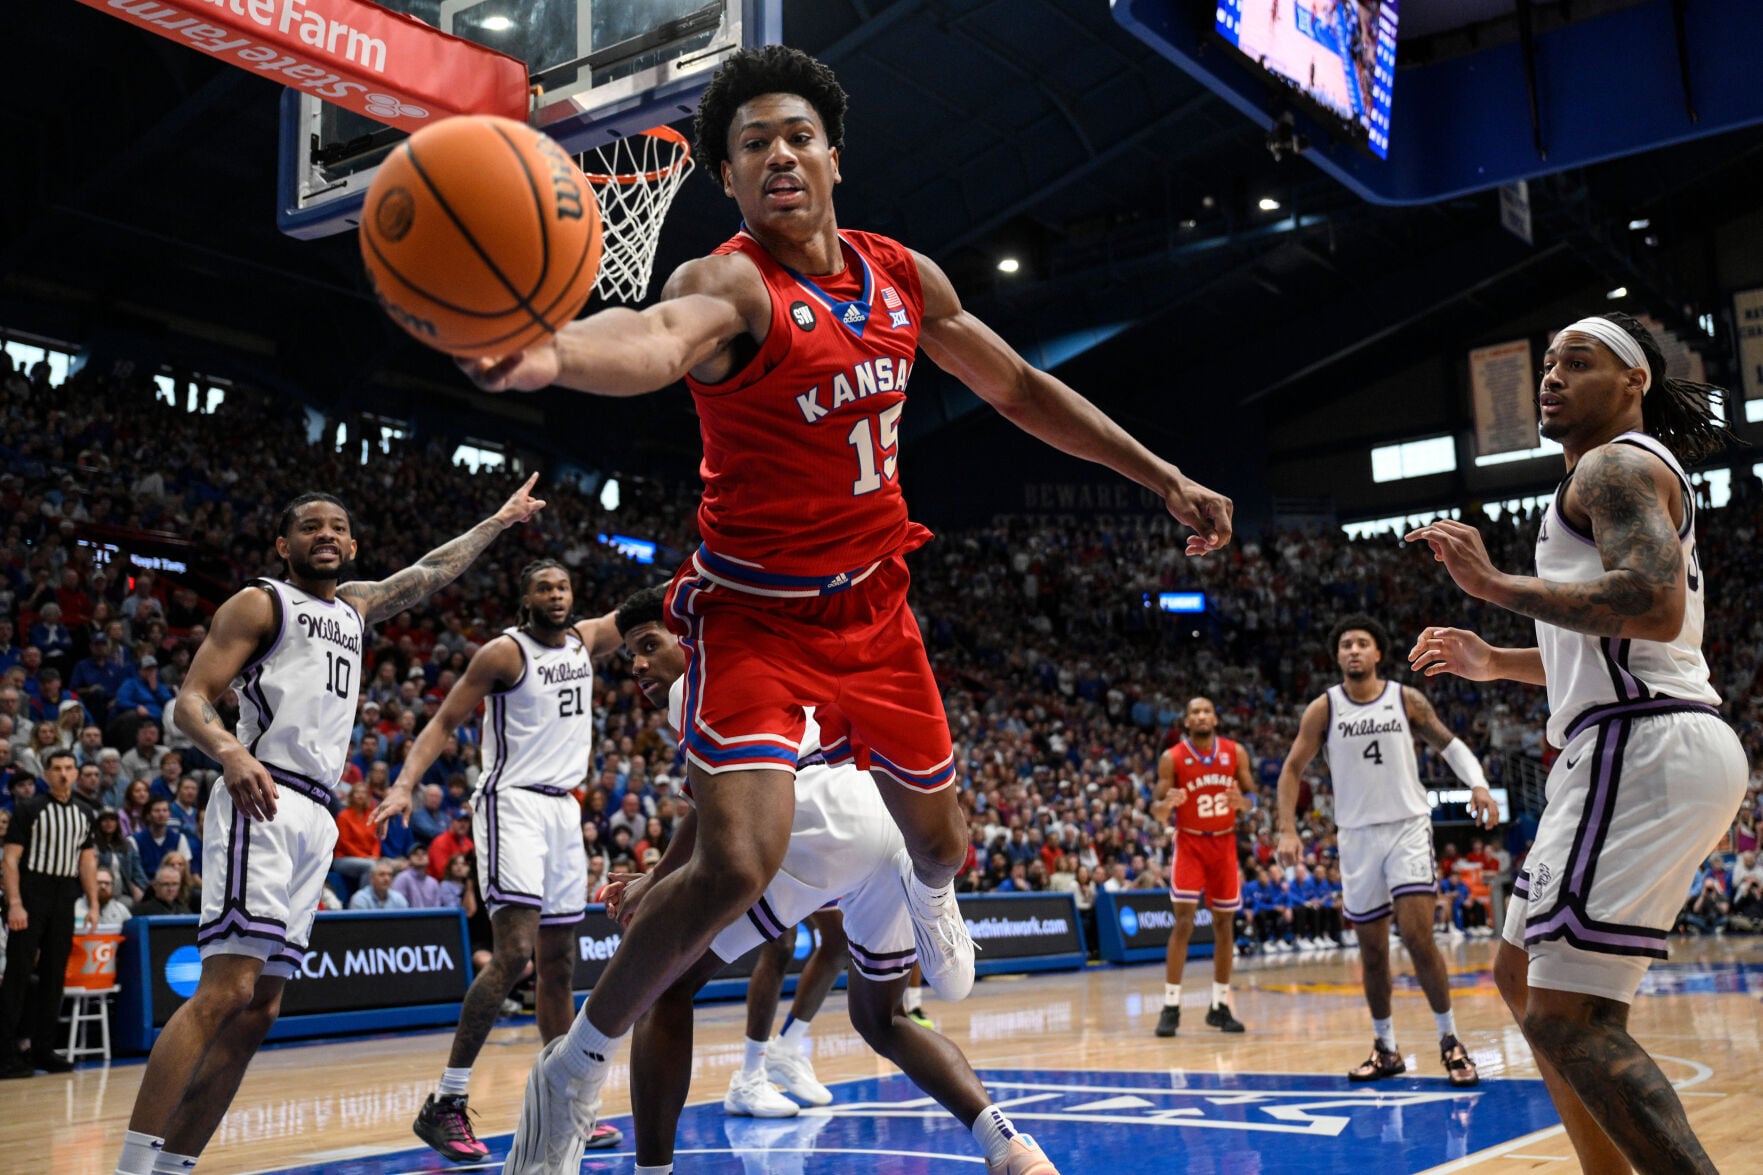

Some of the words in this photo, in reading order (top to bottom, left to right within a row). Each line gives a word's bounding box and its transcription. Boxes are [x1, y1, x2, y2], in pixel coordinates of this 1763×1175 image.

[793, 305, 814, 325] SW
[843, 314, 866, 324] adidas
[795, 356, 914, 424] KANSA
[848, 400, 905, 496] 15
[298, 613, 361, 656] Wildcat
[326, 651, 351, 699] 10
[537, 662, 591, 686] Wildcat
[558, 686, 584, 718] 21
[1338, 718, 1403, 738] Wildcats
[1363, 740, 1383, 765] 4
[1196, 793, 1230, 818] 22
[95, 943, 113, 962] G
[343, 945, 455, 977] MINOLTA
